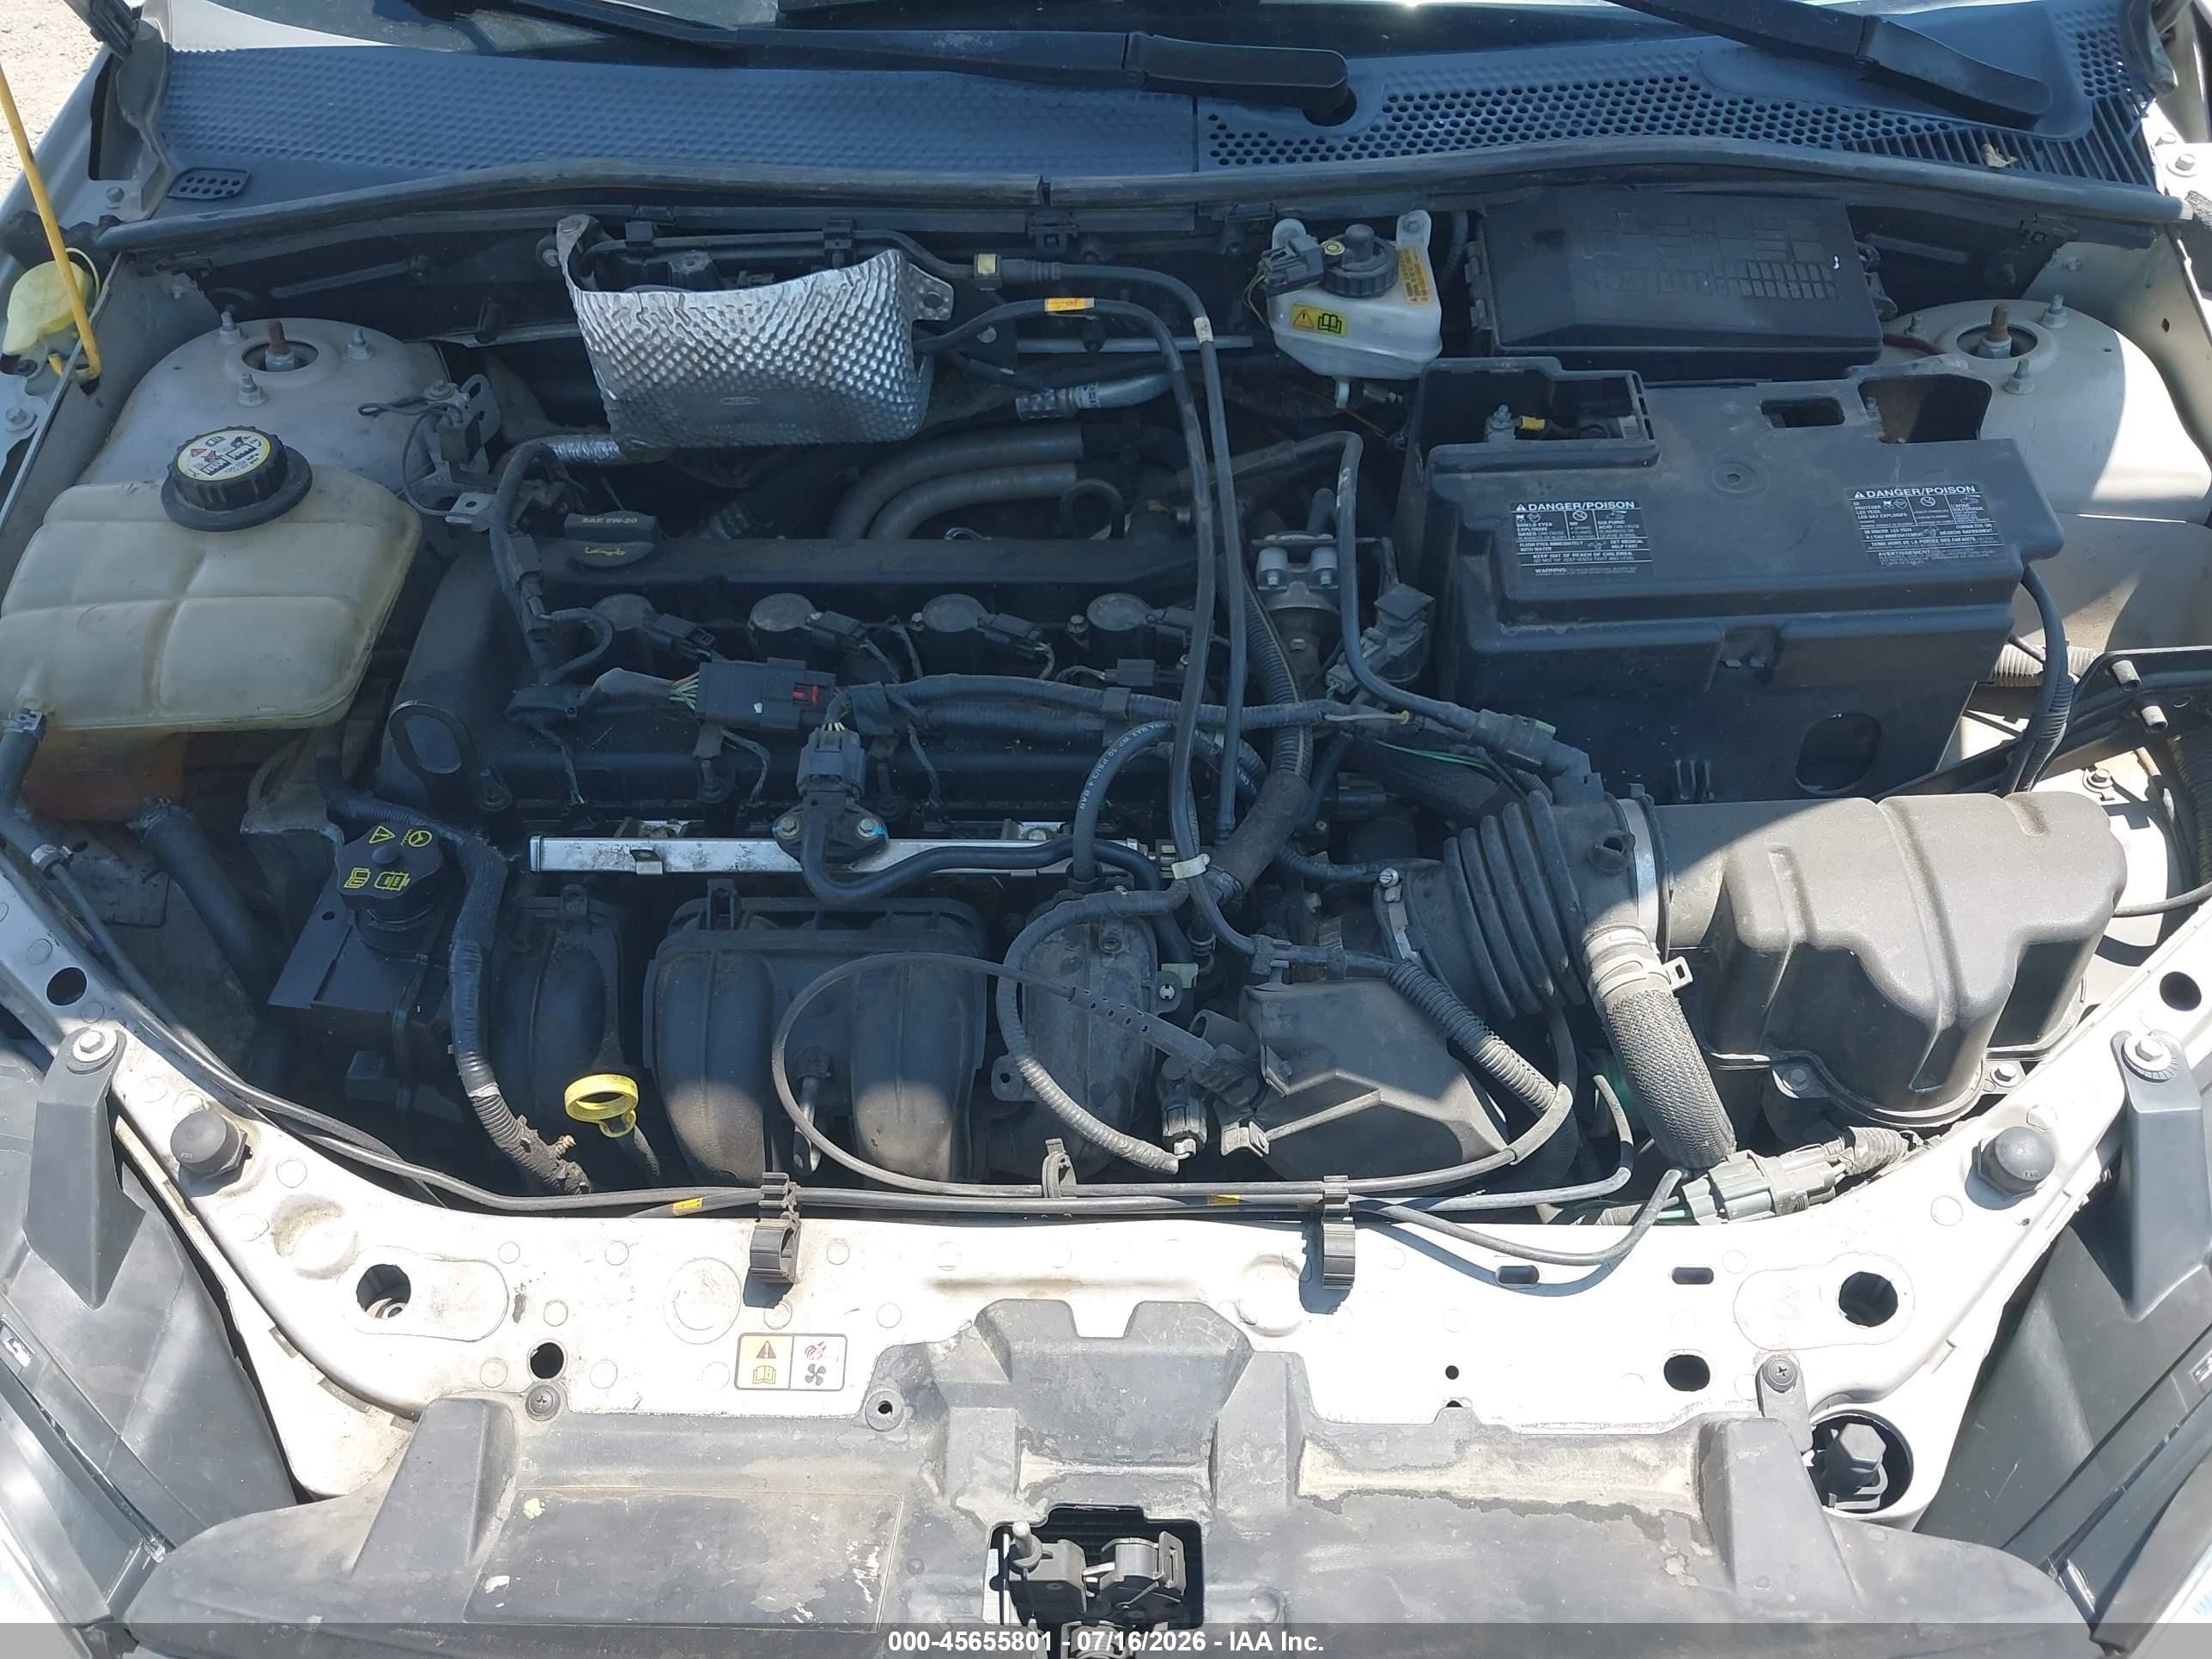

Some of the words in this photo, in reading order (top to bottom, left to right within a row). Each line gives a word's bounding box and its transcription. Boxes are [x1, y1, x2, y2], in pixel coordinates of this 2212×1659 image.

[1866, 485, 1975, 497] DANGER/POISON
[1528, 501, 1634, 511] DANGER/POISON
[1079, 789, 1091, 811] BAR
